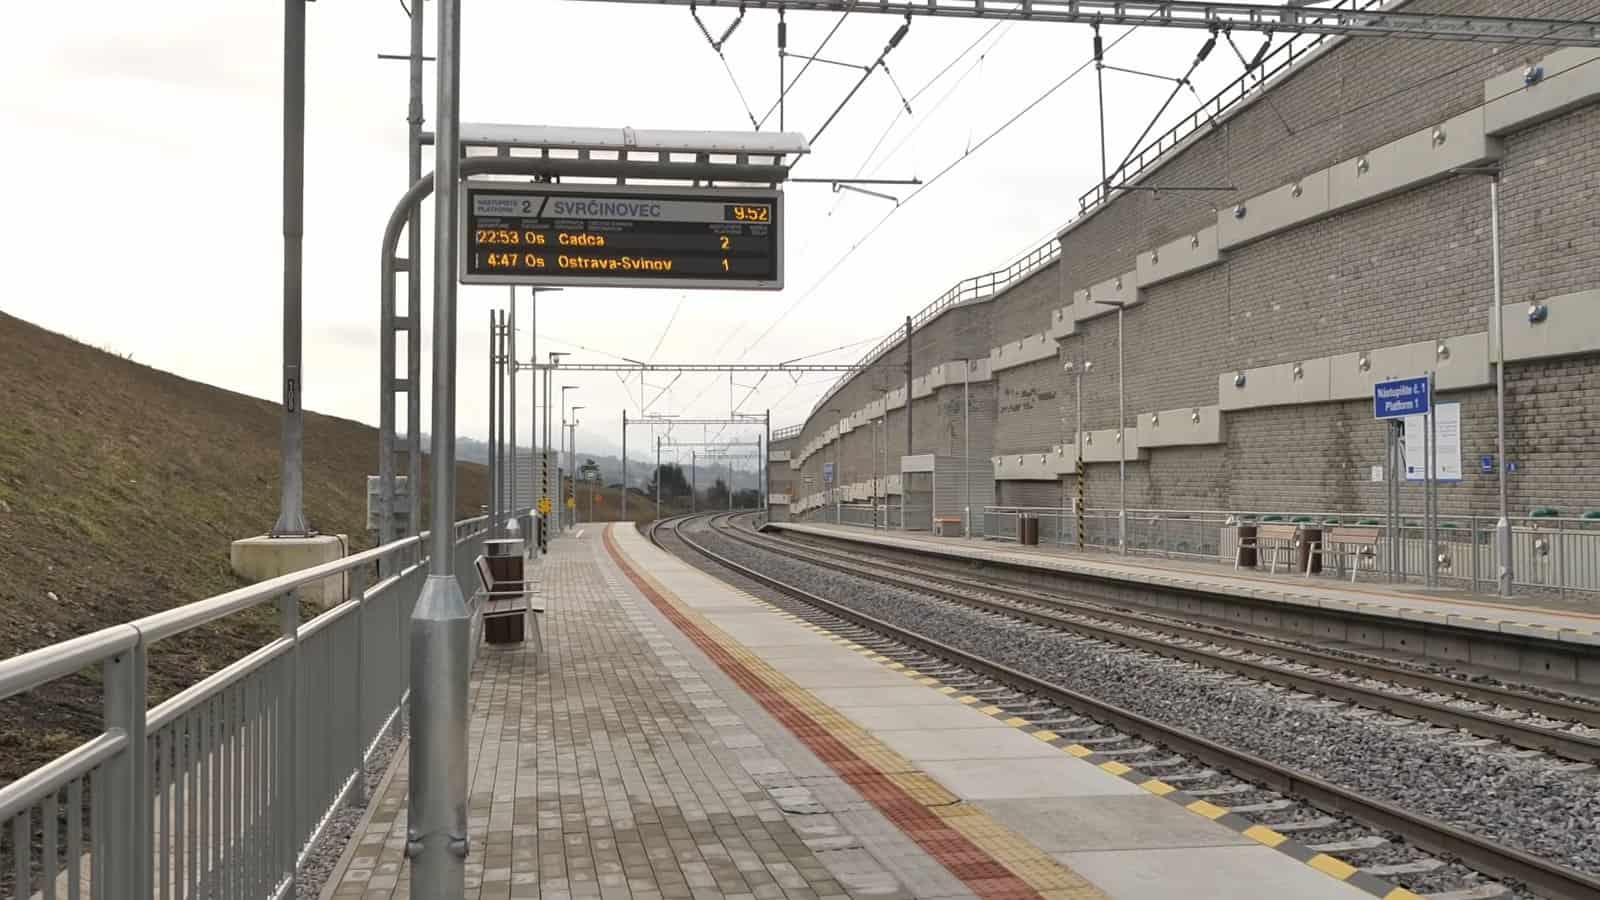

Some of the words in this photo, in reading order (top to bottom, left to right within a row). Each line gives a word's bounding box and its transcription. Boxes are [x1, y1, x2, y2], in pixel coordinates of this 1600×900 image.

[522, 200, 532, 214] 2
[554, 201, 661, 217] SVRČINOVEC
[479, 230, 520, 245] 22:53
[525, 231, 545, 245] Os
[720, 235, 730, 249] 2
[488, 253, 519, 267] 4:47
[525, 254, 545, 268] Os
[558, 255, 673, 271] Ostrava-Svinov
[721, 257, 729, 272] 1
[1385, 399, 1413, 412] Platform
